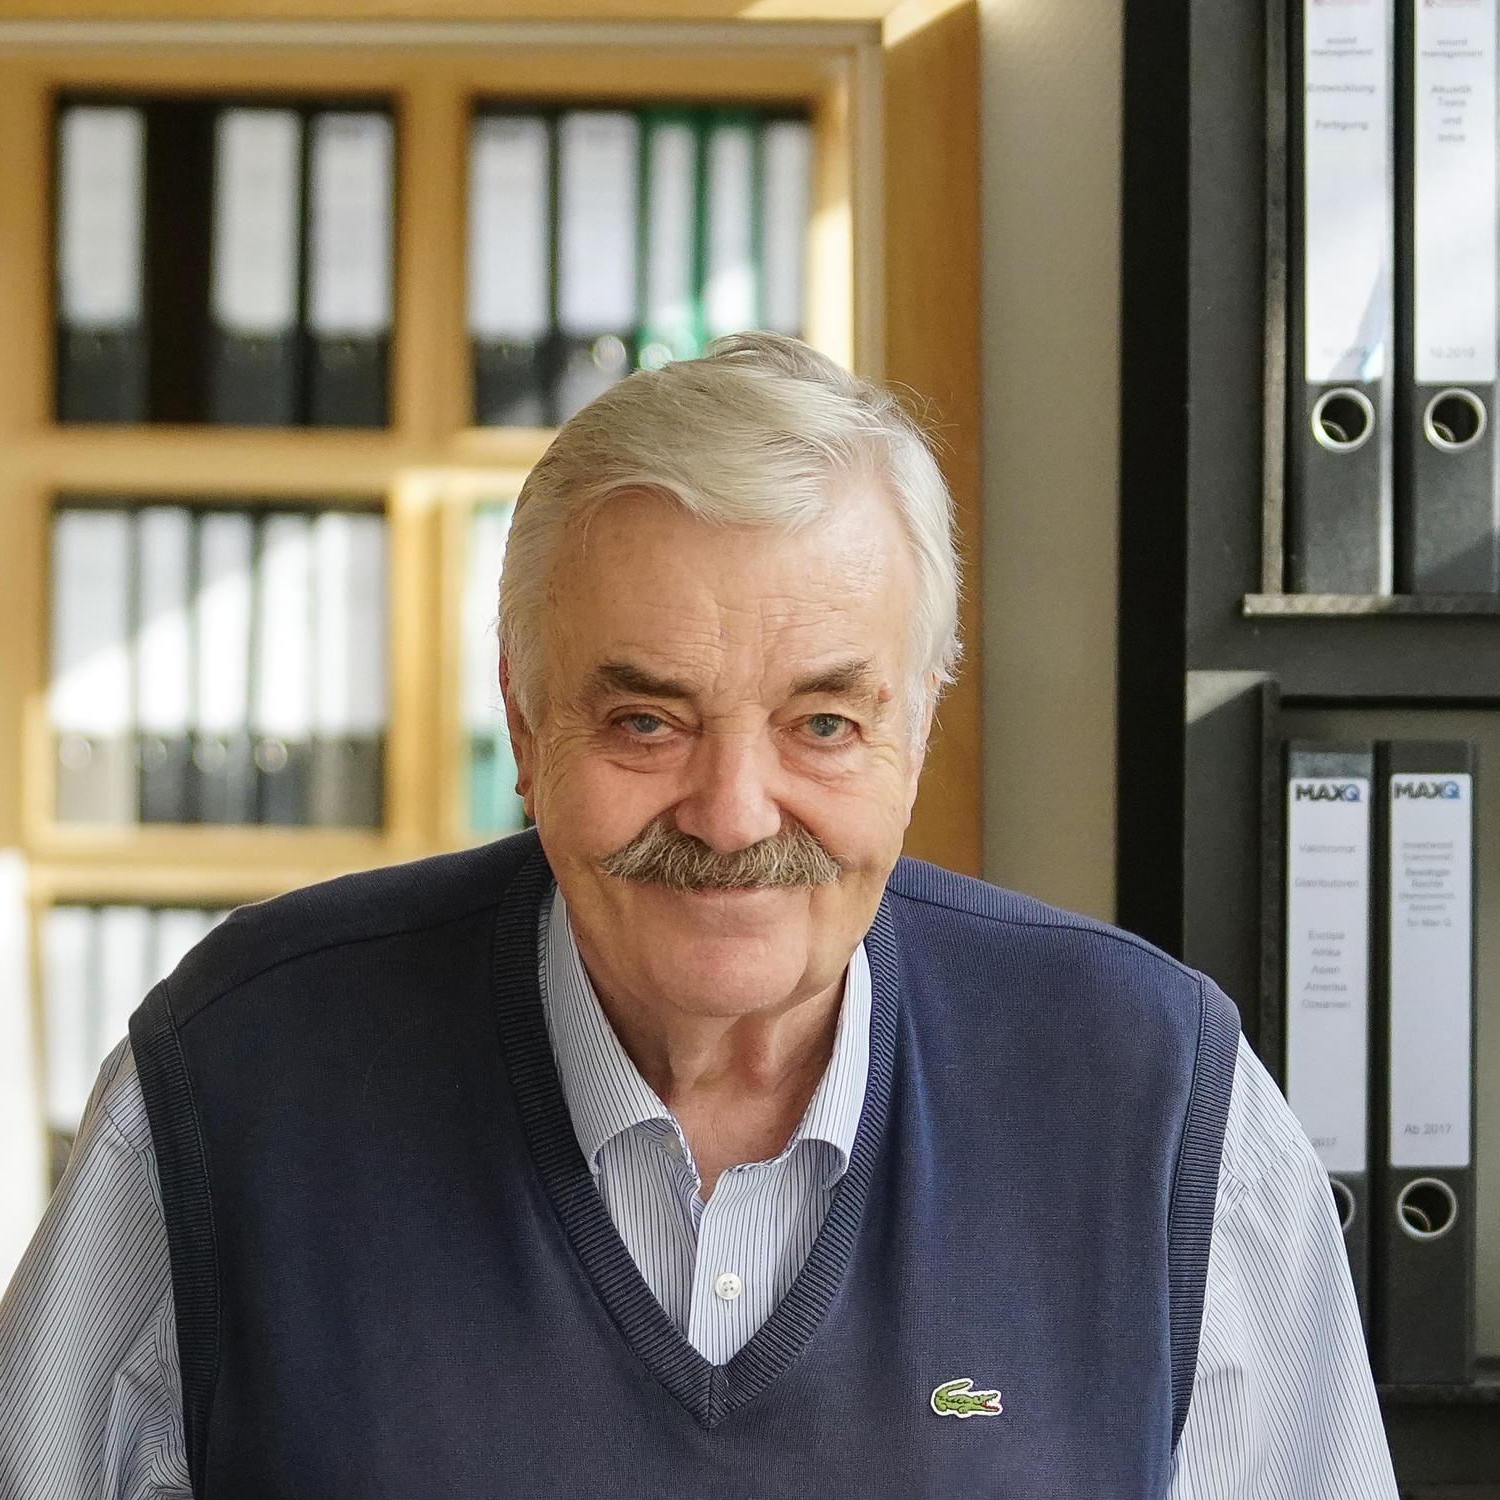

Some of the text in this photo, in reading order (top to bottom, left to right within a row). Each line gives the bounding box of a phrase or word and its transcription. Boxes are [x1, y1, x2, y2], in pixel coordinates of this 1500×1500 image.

[1295, 783, 1361, 802] MAXQ
[1394, 781, 1460, 800] MAXQ
[1424, 1123, 1452, 1136] 2017
